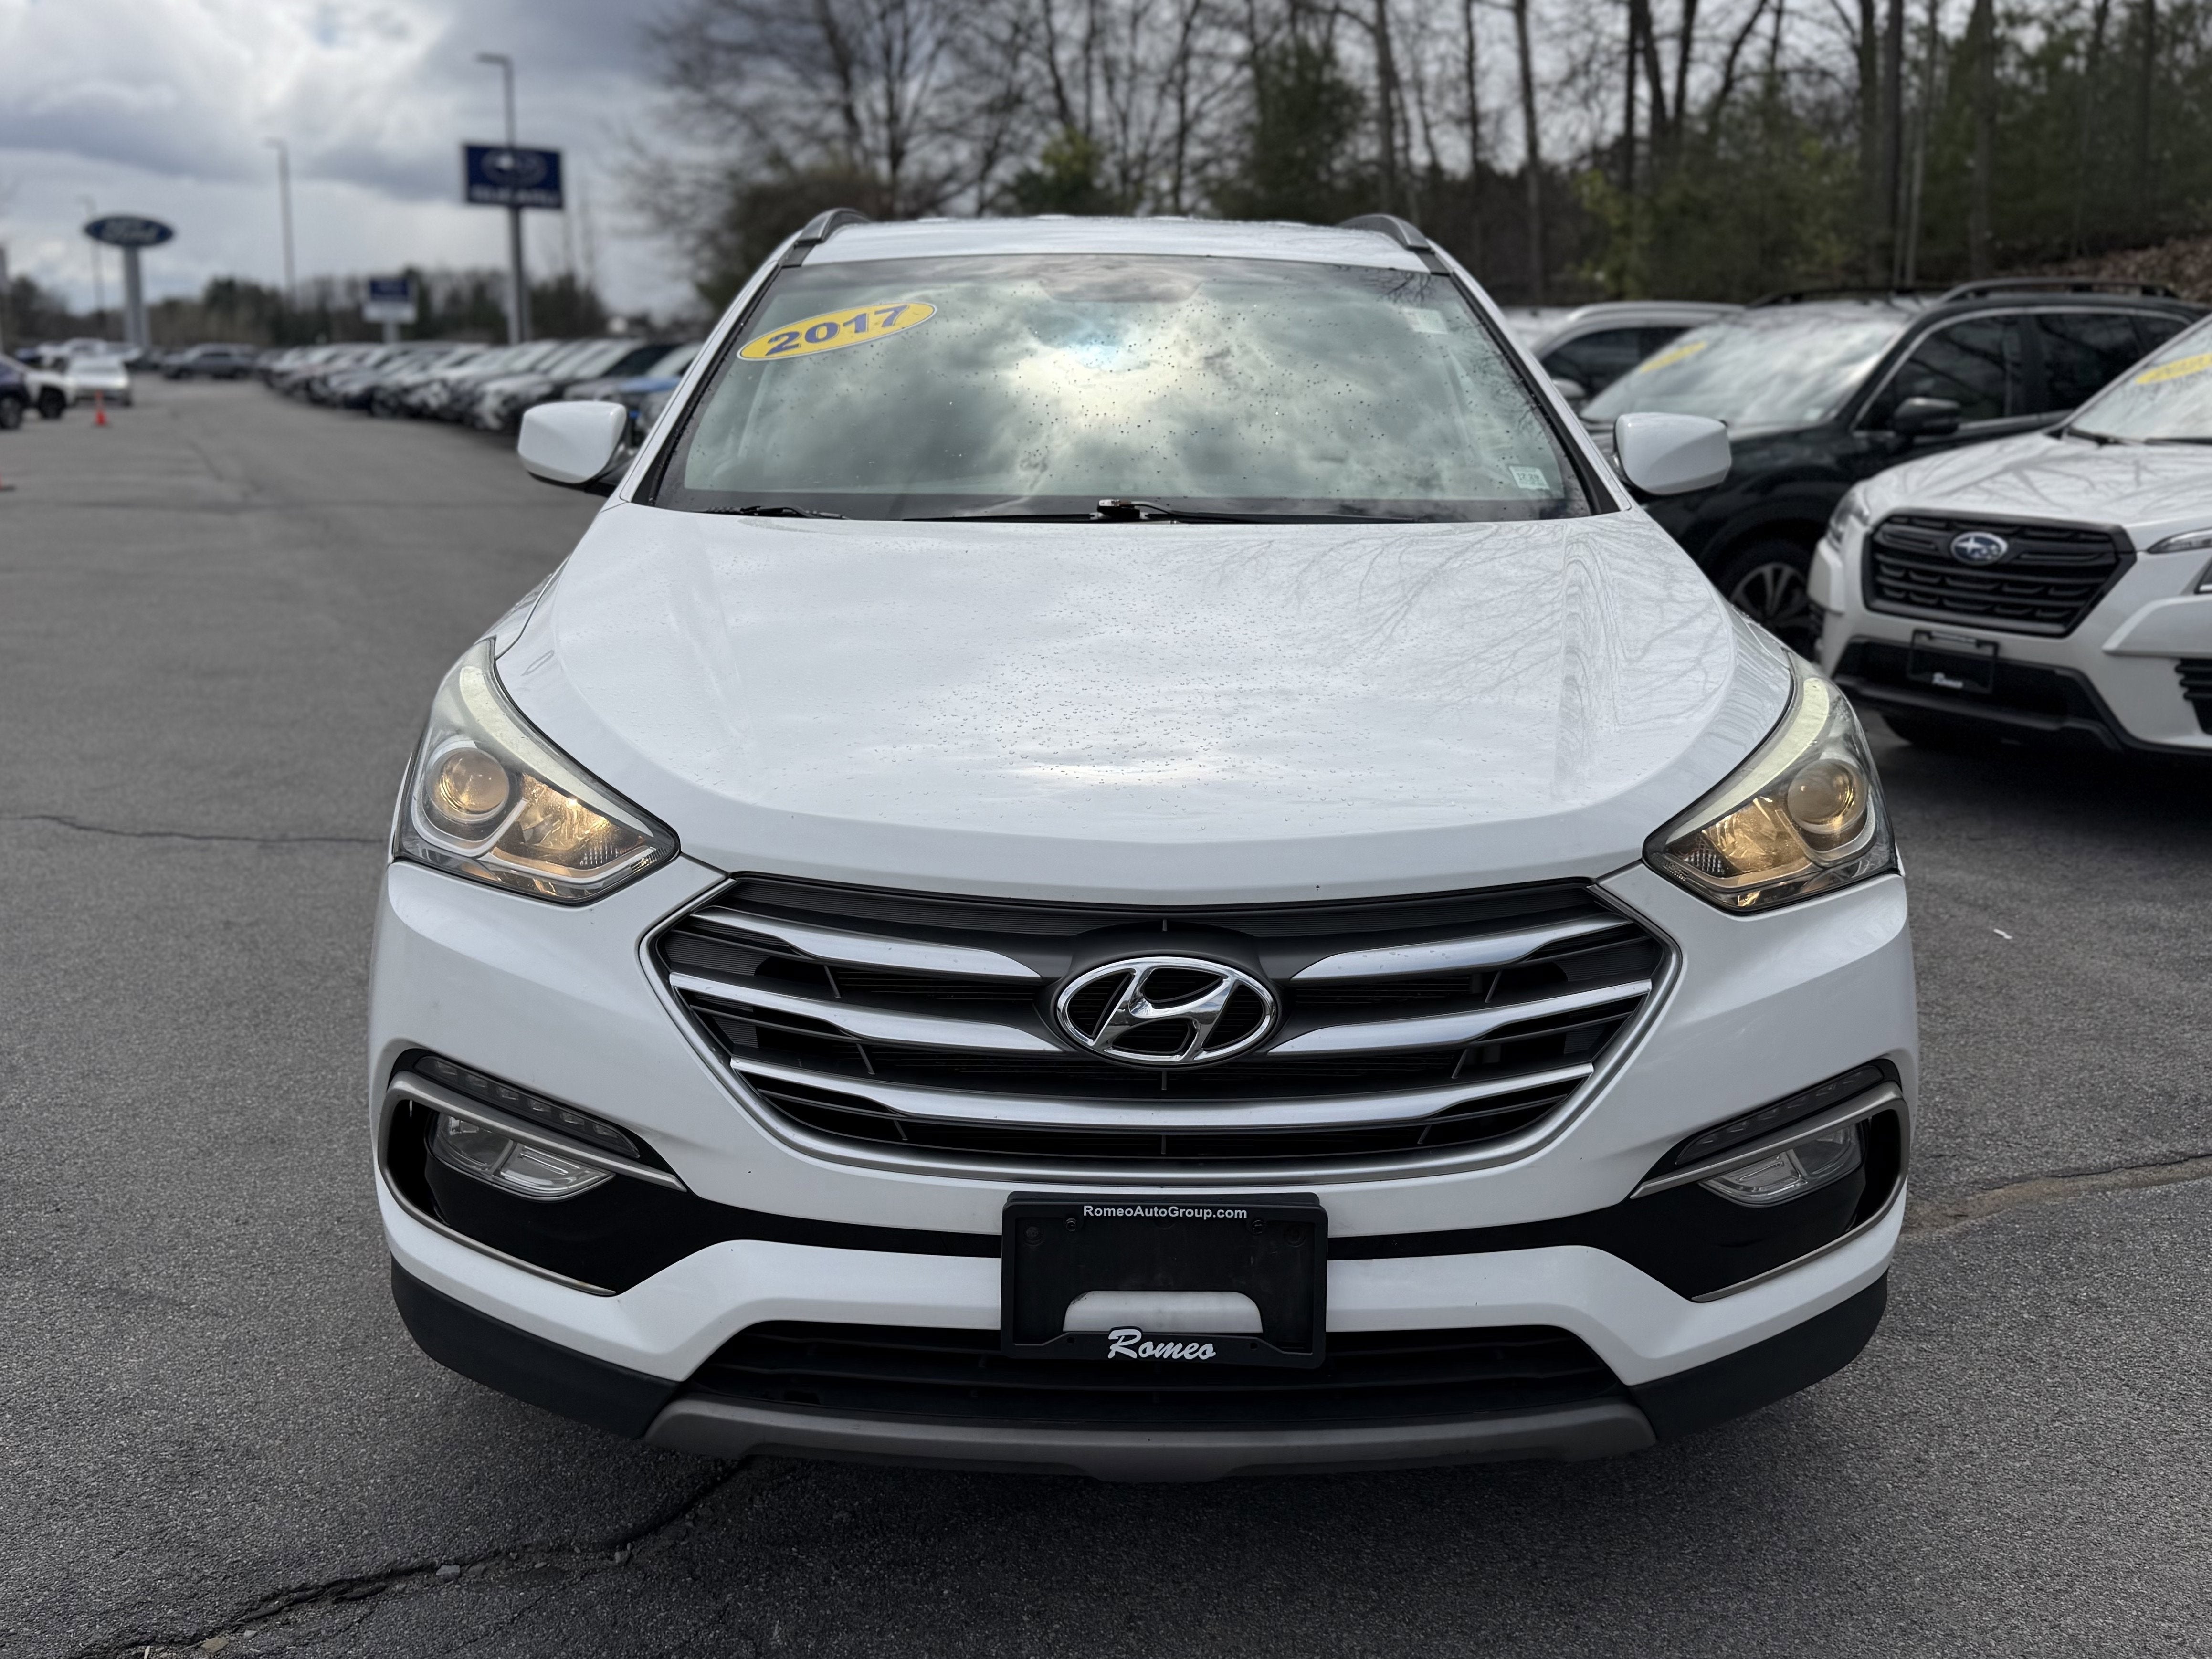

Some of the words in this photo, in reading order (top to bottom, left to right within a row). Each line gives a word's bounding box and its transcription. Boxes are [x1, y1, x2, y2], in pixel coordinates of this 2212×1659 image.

[765, 304, 909, 356] 2017
[1084, 1205, 1247, 1220] RomeoAutoGroup.com
[1107, 1329, 1216, 1360] Romeo
